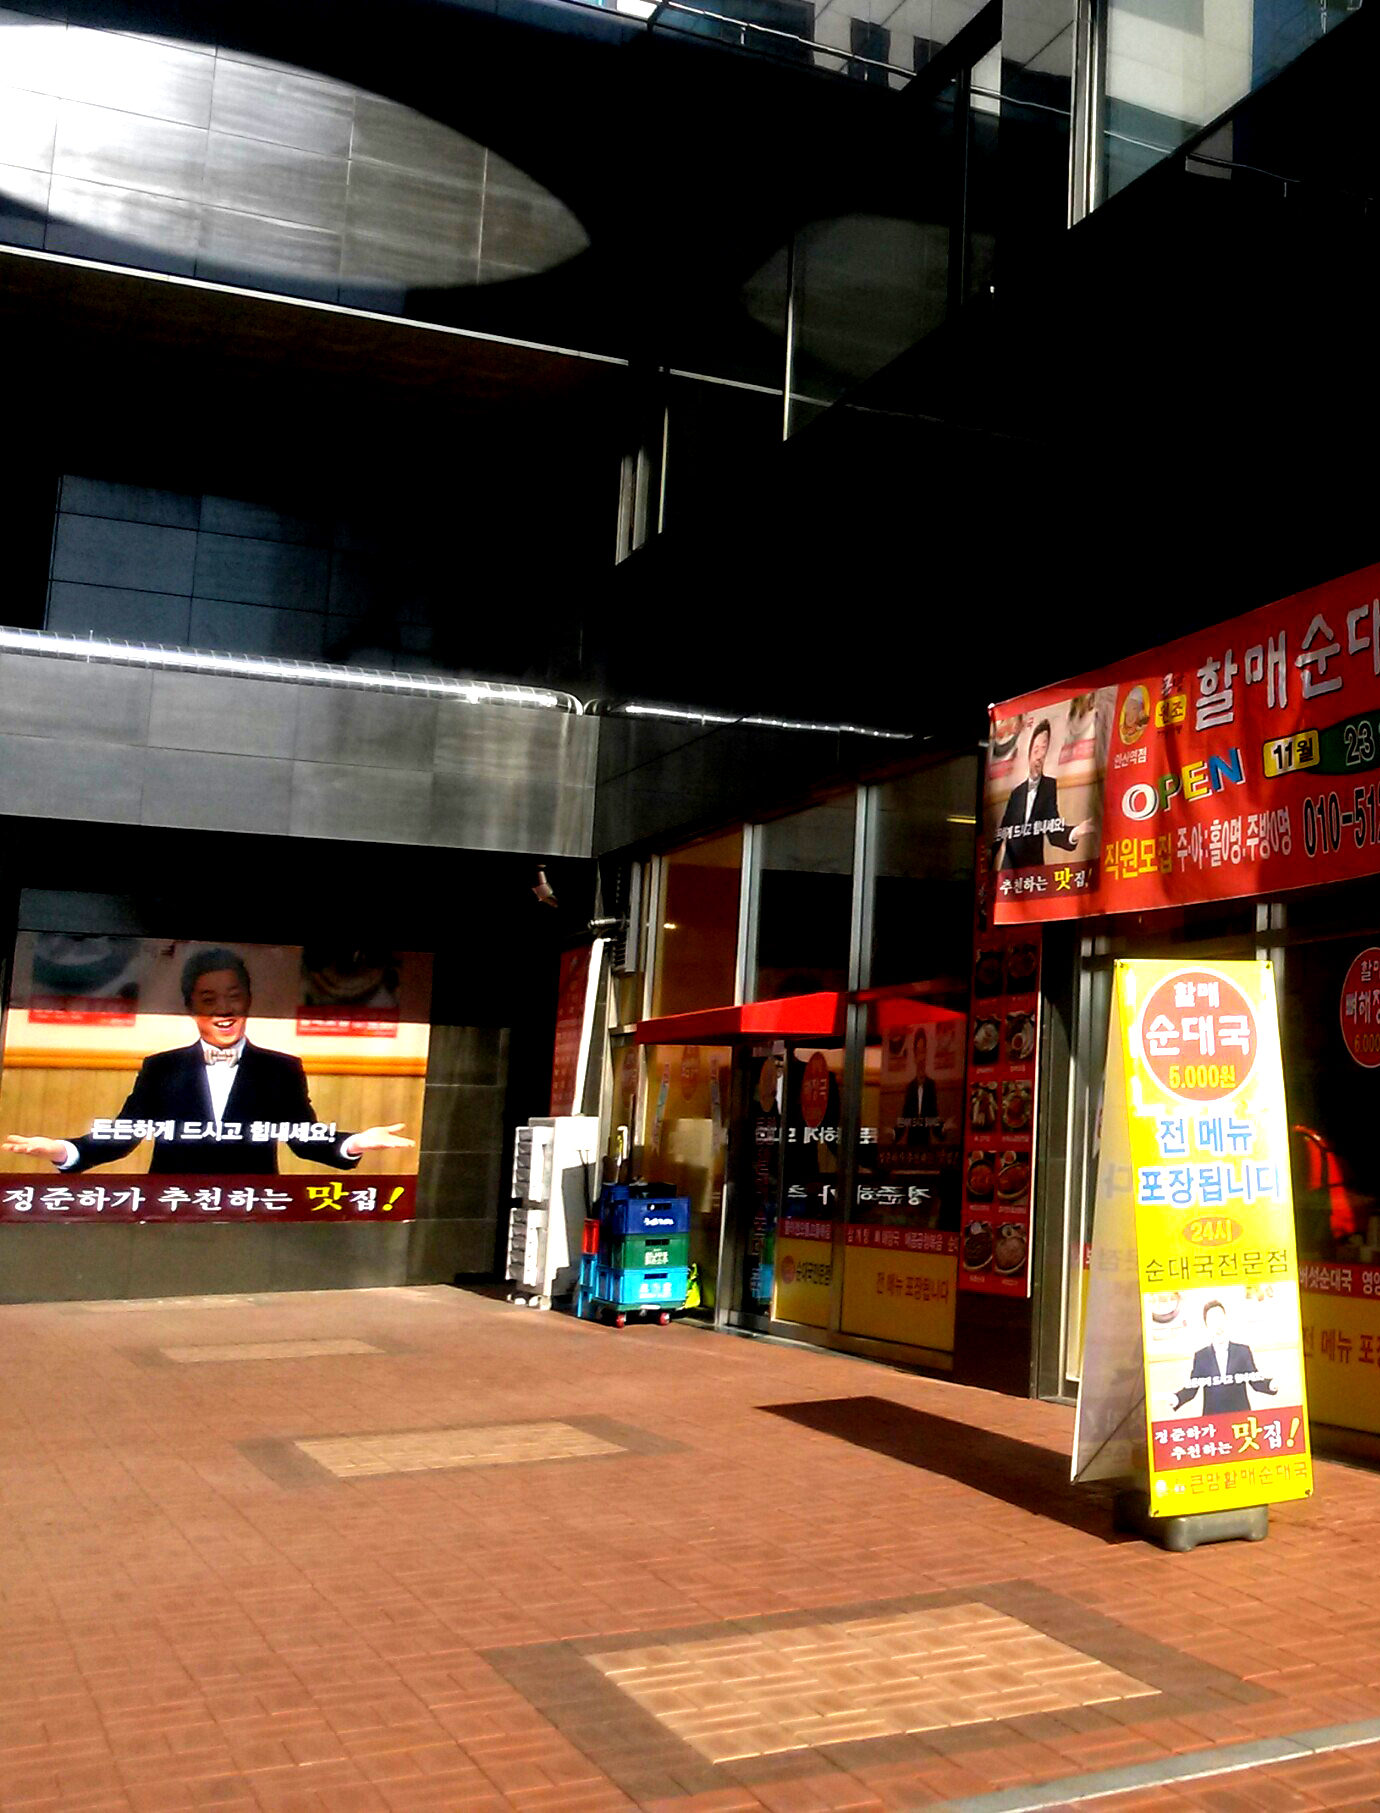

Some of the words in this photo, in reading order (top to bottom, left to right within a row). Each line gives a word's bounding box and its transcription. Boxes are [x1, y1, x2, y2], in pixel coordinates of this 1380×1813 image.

[1121, 747, 1246, 821] OPEN
[1104, 833, 1172, 881] 직원모집
[1054, 867, 1093, 892] 맛집!
[1174, 981, 1220, 1008] 할매
[1146, 1014, 1251, 1056] 순대국
[91, 1119, 174, 1141] 든든하게
[180, 1121, 243, 1141] 드시고
[1160, 1117, 1186, 1153] 전
[1199, 1117, 1253, 1153] 메뉴
[5, 1186, 146, 1213] 정준하가
[157, 1186, 293, 1213] 추천하는
[306, 1181, 405, 1213] 맛집!
[1141, 1164, 1281, 1205] 포장됩니다
[1145, 1249, 1289, 1284] 순대국전문점
[1321, 1329, 1353, 1364] 메뉴
[1154, 1423, 1217, 1445] 정준하가
[1231, 1415, 1301, 1454] 맛집!
